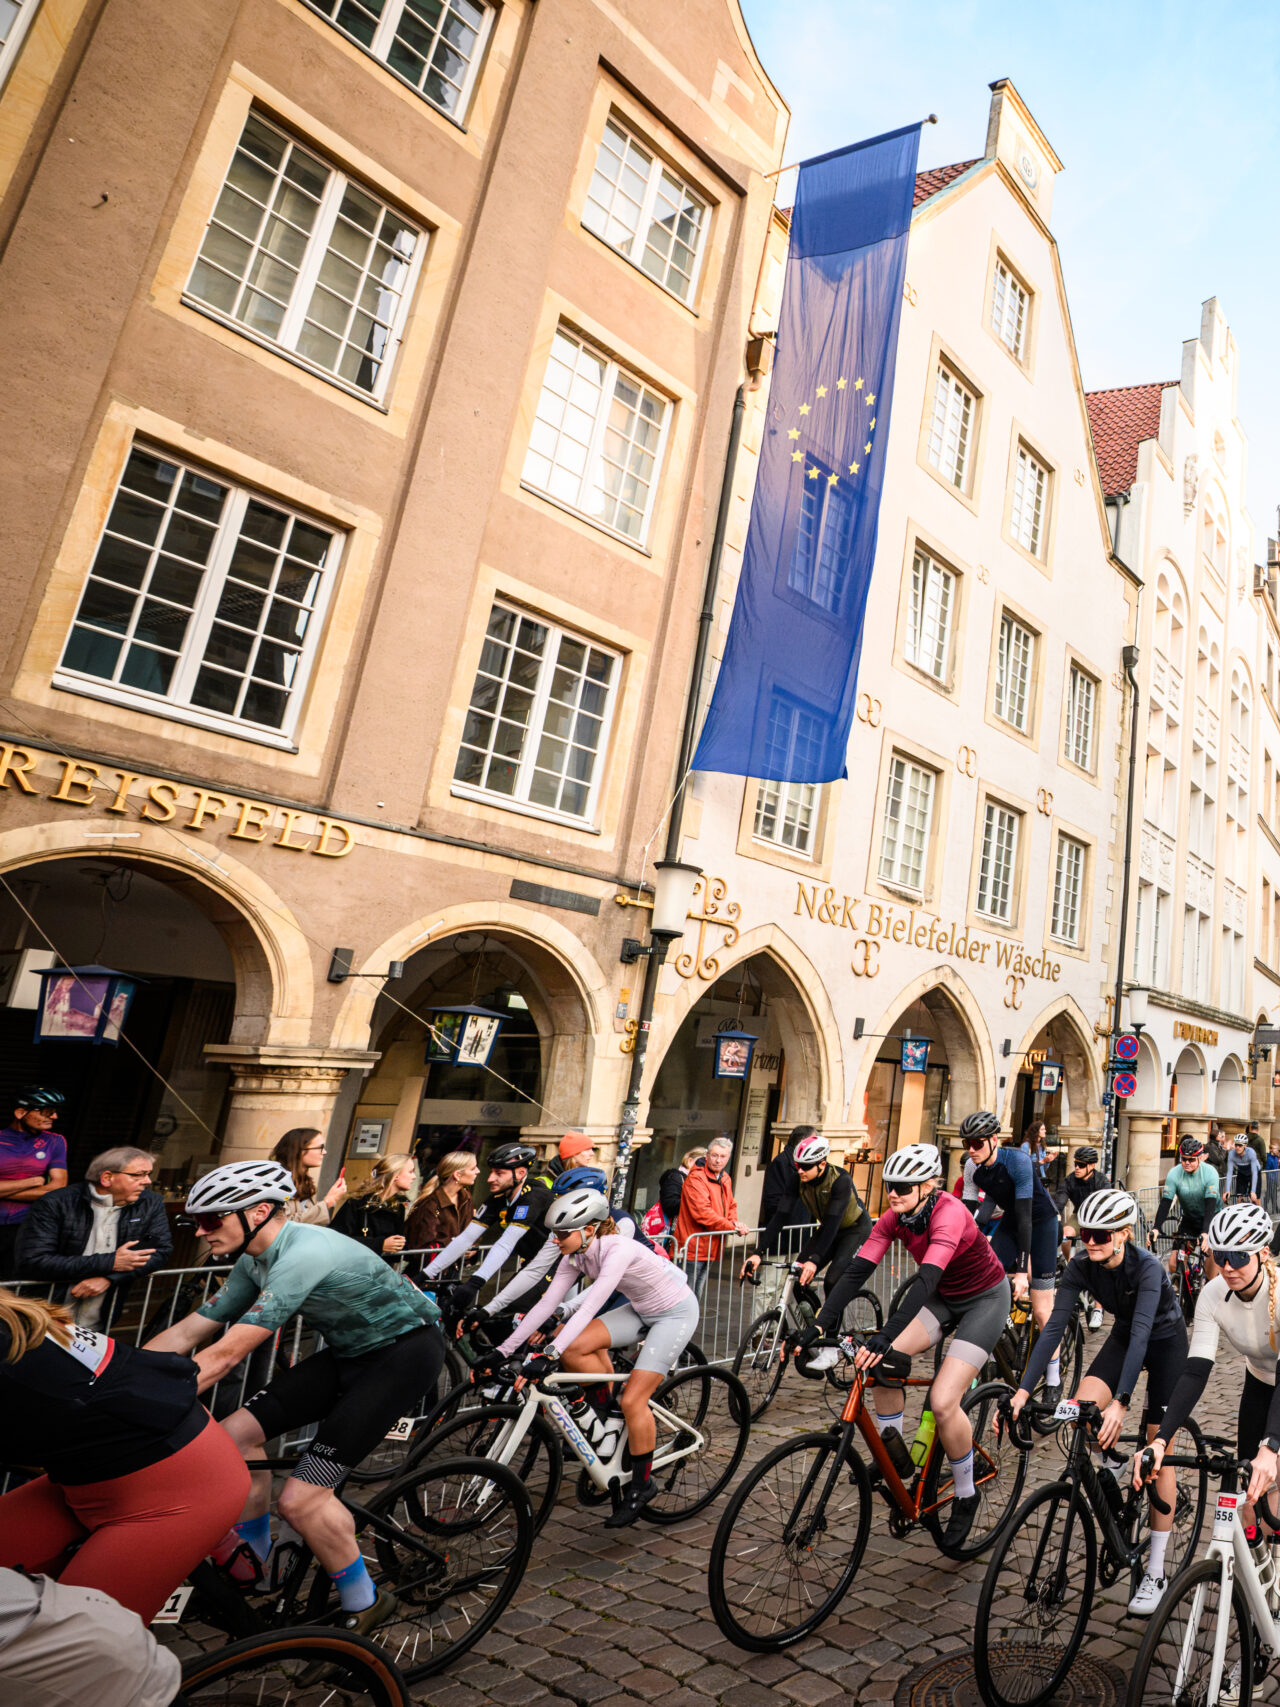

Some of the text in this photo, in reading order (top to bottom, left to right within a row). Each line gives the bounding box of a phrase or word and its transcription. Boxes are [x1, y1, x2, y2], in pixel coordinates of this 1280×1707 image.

[0, 745, 356, 858] REISFELD
[794, 881, 1062, 983] N&K Bielefelder Wäsche
[549, 1401, 597, 1467] ORBEA
[1058, 1406, 1078, 1416] 3474
[312, 1442, 337, 1457] GORE
